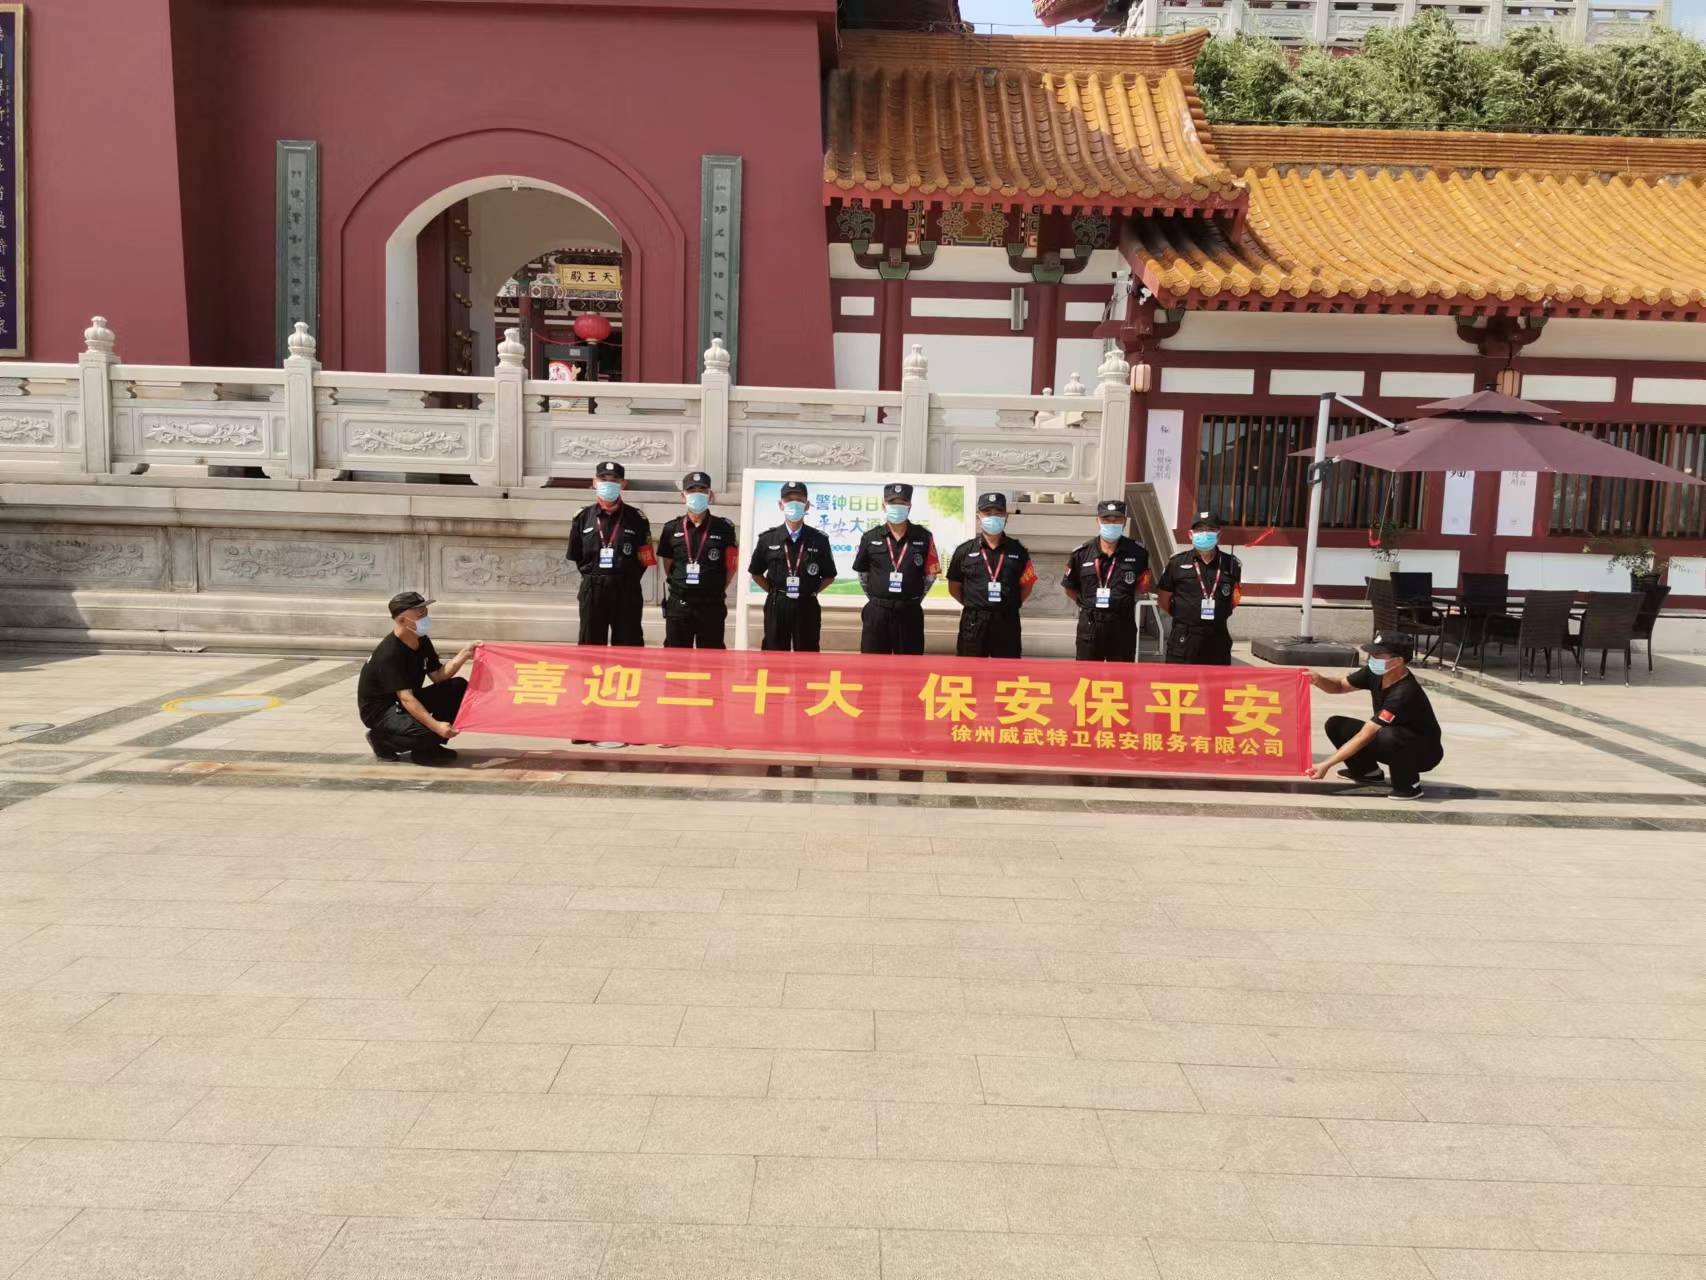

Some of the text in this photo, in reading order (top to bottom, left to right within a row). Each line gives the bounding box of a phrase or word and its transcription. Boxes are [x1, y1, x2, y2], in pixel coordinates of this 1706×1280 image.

[570, 270, 615, 284] 天王殿
[811, 494, 884, 512] 警钟日日
[507, 661, 1283, 736] 喜迎二十大 保安保平安
[950, 724, 1284, 757] 徐州威武特卫保安服务有限公司
